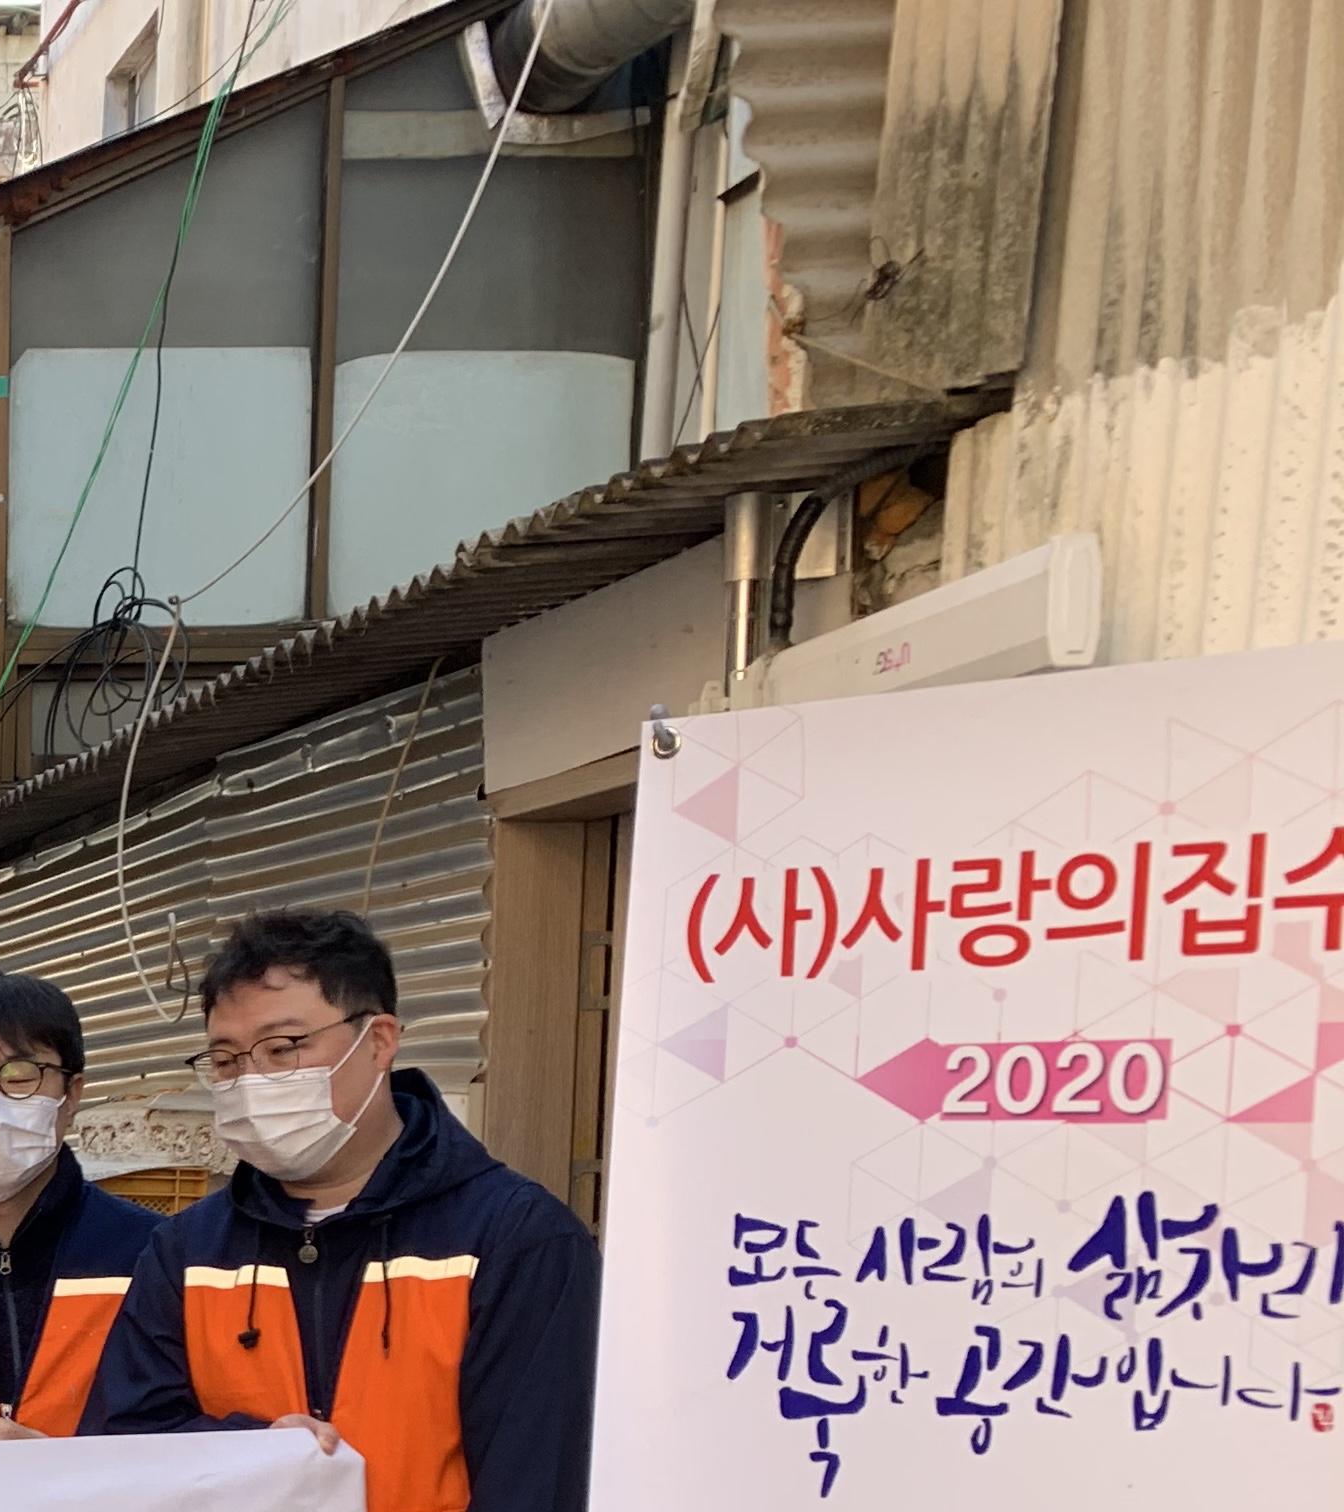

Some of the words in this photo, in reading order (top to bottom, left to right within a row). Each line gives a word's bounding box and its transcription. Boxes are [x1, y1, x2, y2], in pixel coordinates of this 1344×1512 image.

[942, 1041, 1166, 1116] 2020
[727, 1213, 842, 1300] 모든
[855, 1213, 1044, 1305] 사람의
[726, 1298, 930, 1498] 거룩한
[935, 1325, 1342, 1456] 공간입니다
